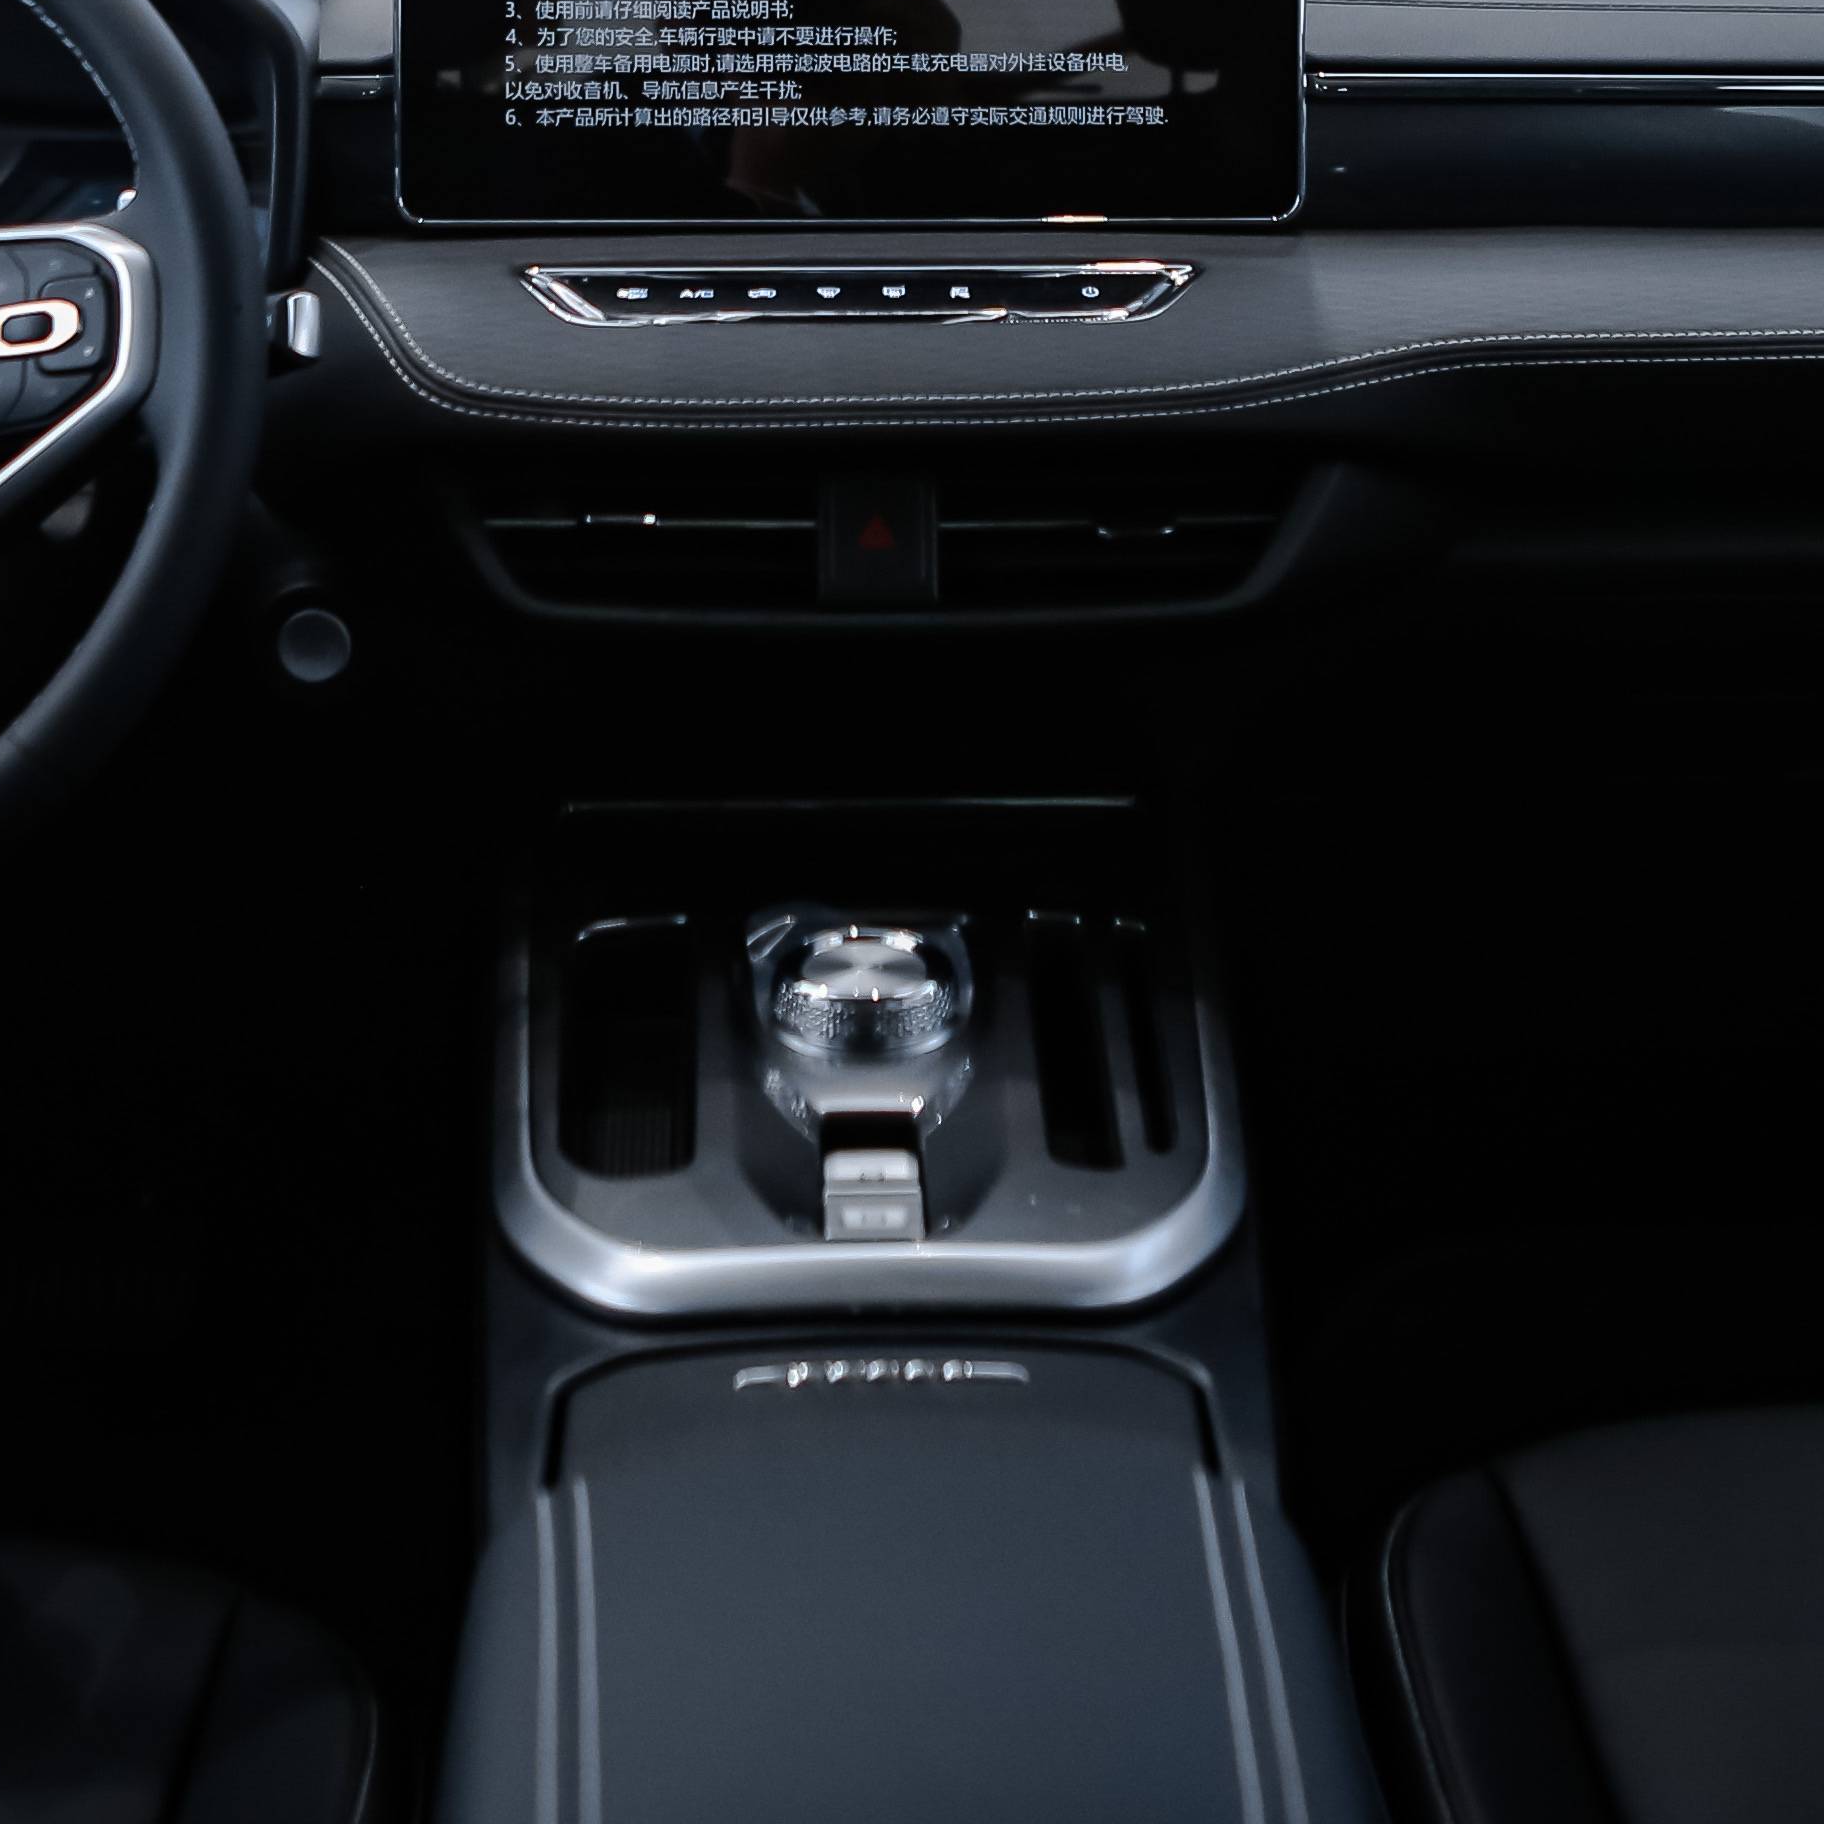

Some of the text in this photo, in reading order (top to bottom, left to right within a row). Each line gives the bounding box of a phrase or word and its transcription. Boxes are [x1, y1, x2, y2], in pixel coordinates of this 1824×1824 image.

[504, 0, 795, 21] 3、使用前请仔细阅读产品说明书;
